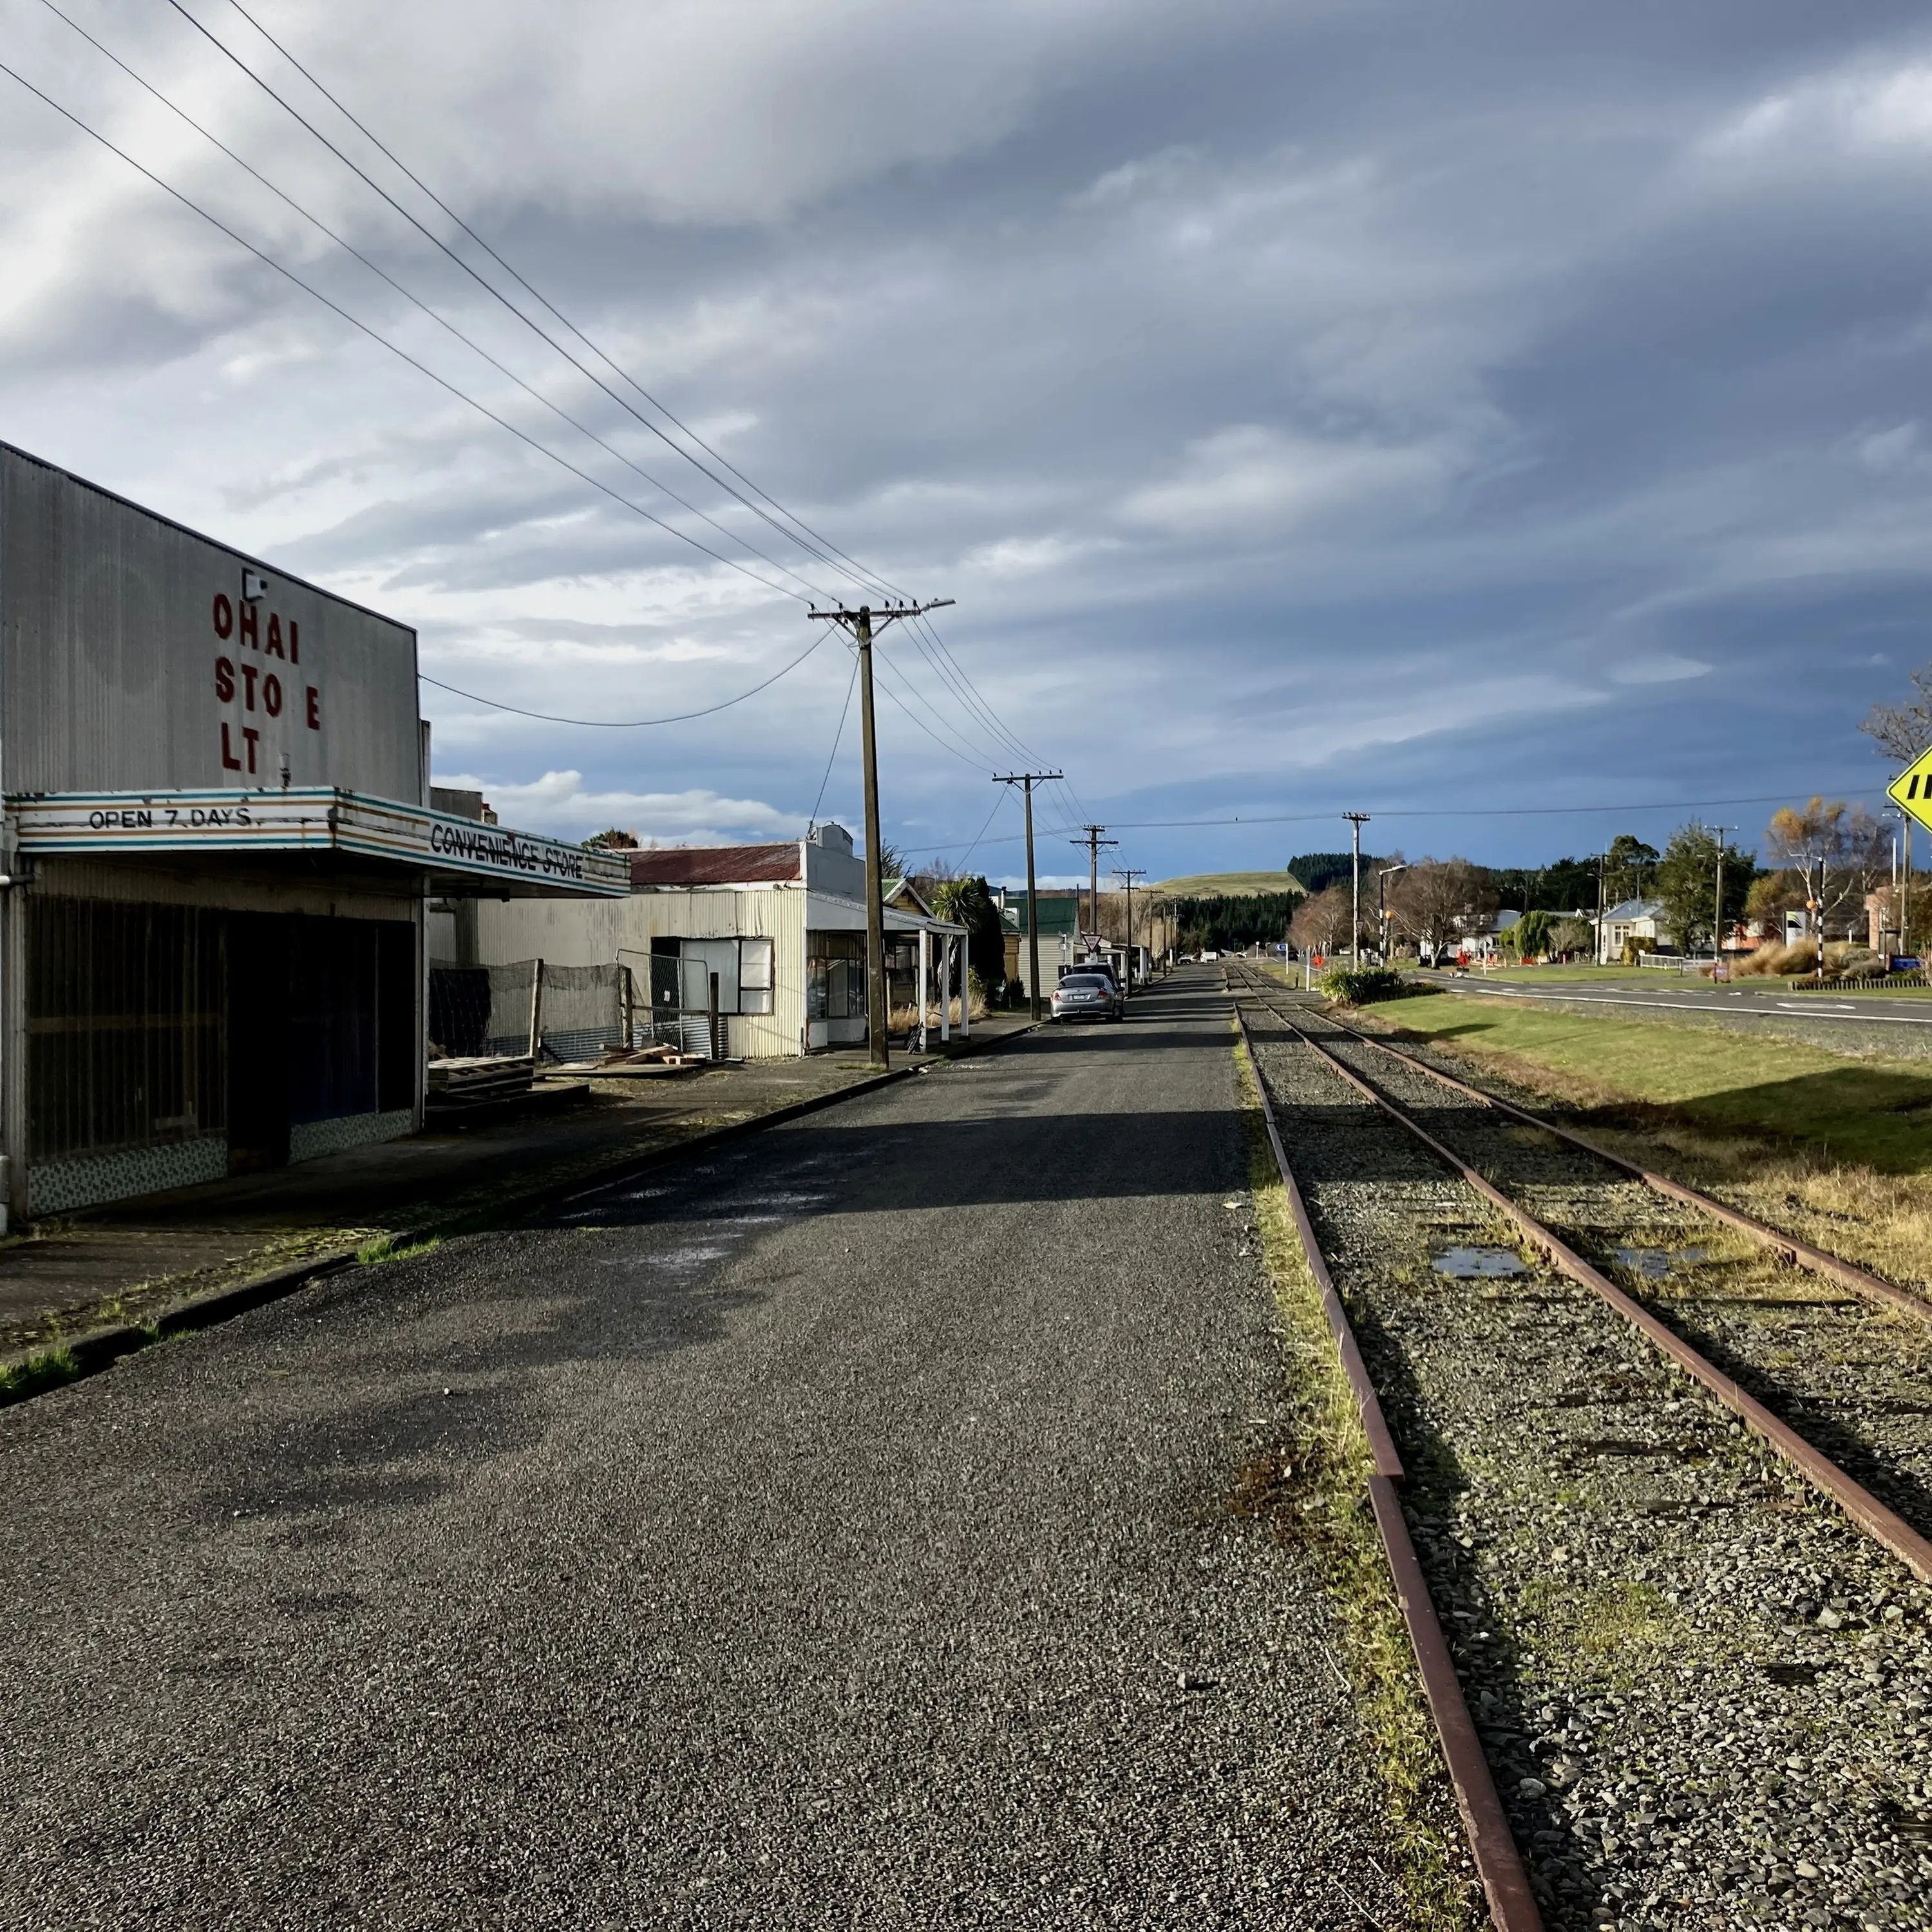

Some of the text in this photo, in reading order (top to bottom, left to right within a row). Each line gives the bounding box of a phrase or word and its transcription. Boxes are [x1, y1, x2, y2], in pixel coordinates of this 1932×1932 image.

[213, 592, 299, 665] OHAI
[215, 656, 321, 731] STOE
[90, 808, 252, 829] OPEN 7 DAYS
[431, 824, 583, 880] CONVENIENCE STORE
